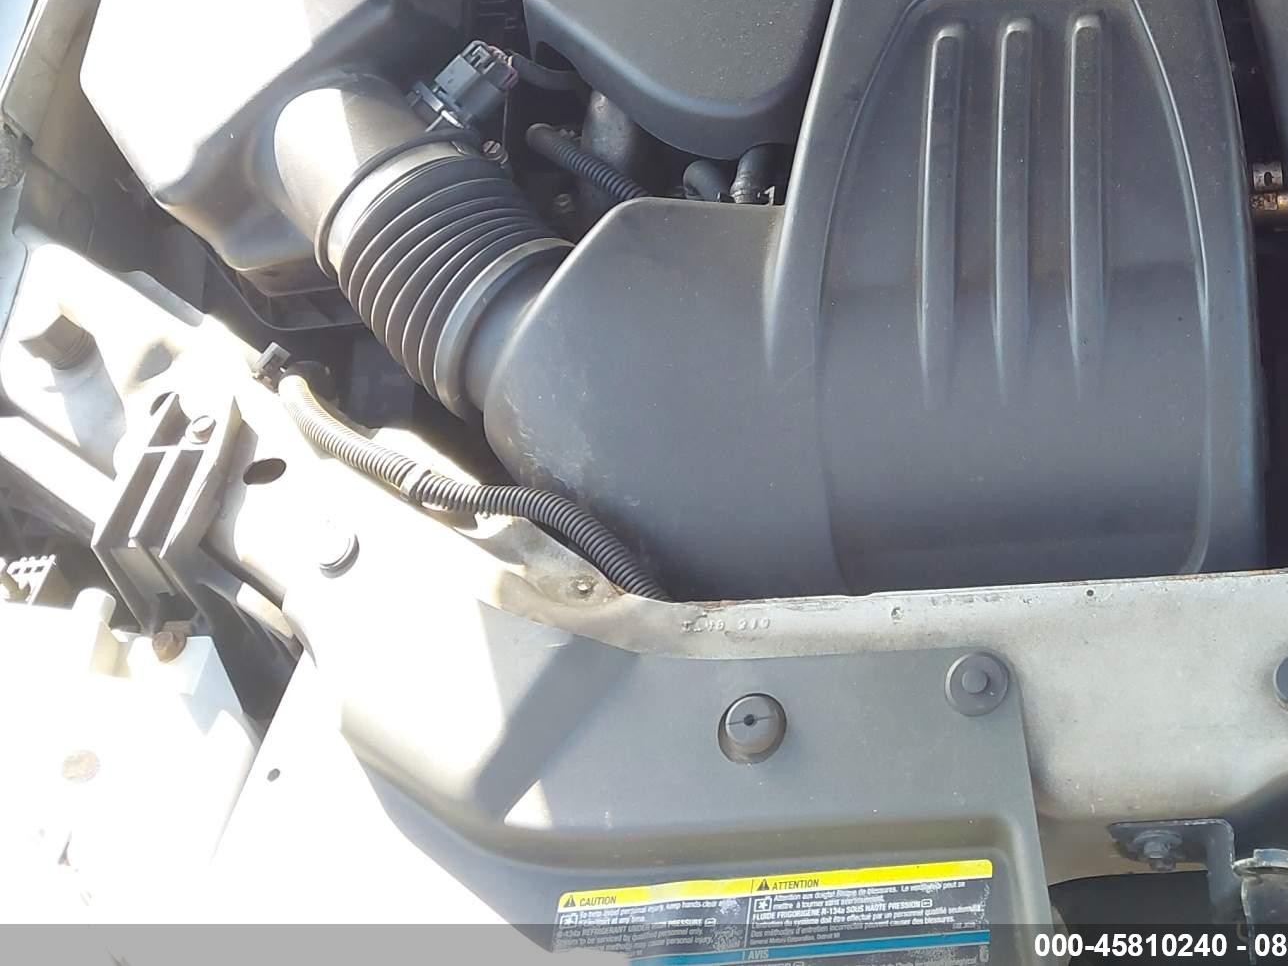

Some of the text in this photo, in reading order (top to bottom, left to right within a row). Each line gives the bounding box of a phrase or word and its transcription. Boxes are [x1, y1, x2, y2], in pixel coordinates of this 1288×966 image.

[772, 879, 820, 891] ATTENTION
[579, 896, 617, 907] CAUTION
[846, 904, 864, 914] SOUS
[865, 902, 887, 912] HAUTE
[887, 900, 921, 911] PRESSION
[749, 949, 769, 960] AVIS
